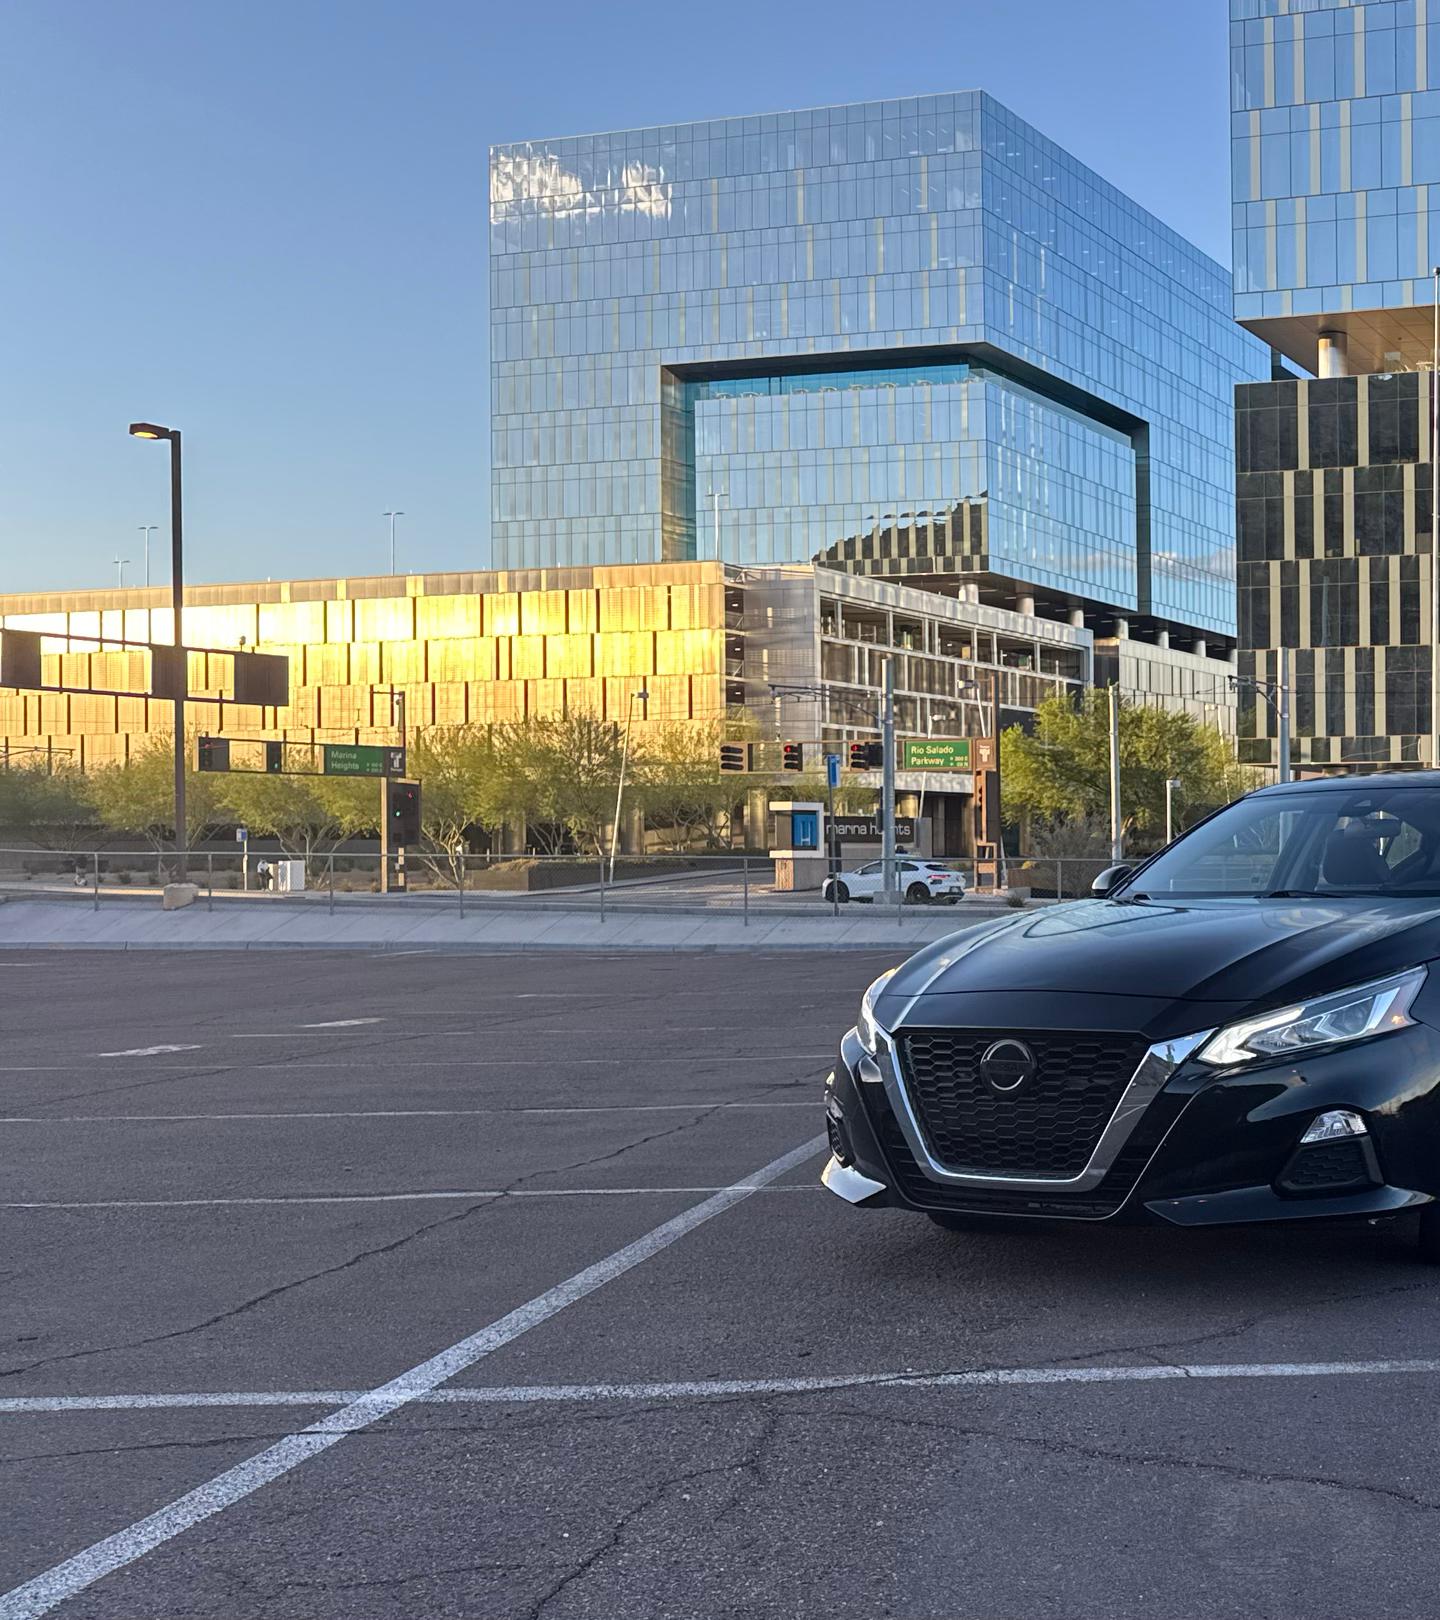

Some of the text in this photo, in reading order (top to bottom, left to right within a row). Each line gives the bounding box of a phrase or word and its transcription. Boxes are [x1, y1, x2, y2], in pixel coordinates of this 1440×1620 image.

[911, 746, 954, 754] Rio Salado
[331, 751, 357, 759] Marina
[911, 757, 944, 766] Parkway
[331, 762, 359, 771] Heights
